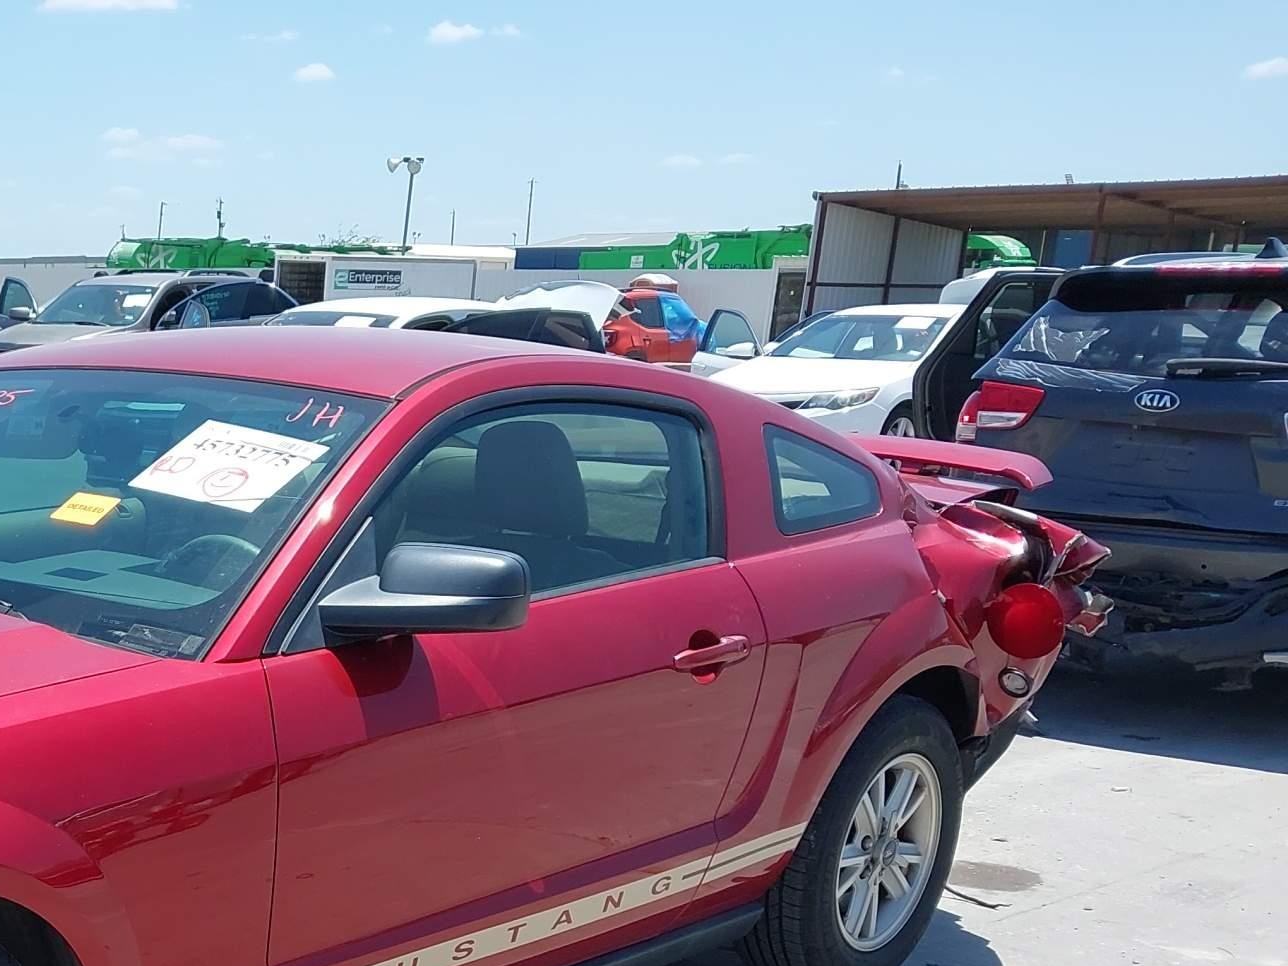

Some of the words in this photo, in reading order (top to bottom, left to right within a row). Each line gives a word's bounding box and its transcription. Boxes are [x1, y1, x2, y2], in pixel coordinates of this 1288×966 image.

[349, 271, 401, 285] Enterprise
[1140, 393, 1171, 408] KIA
[193, 437, 291, 468] 45732775
